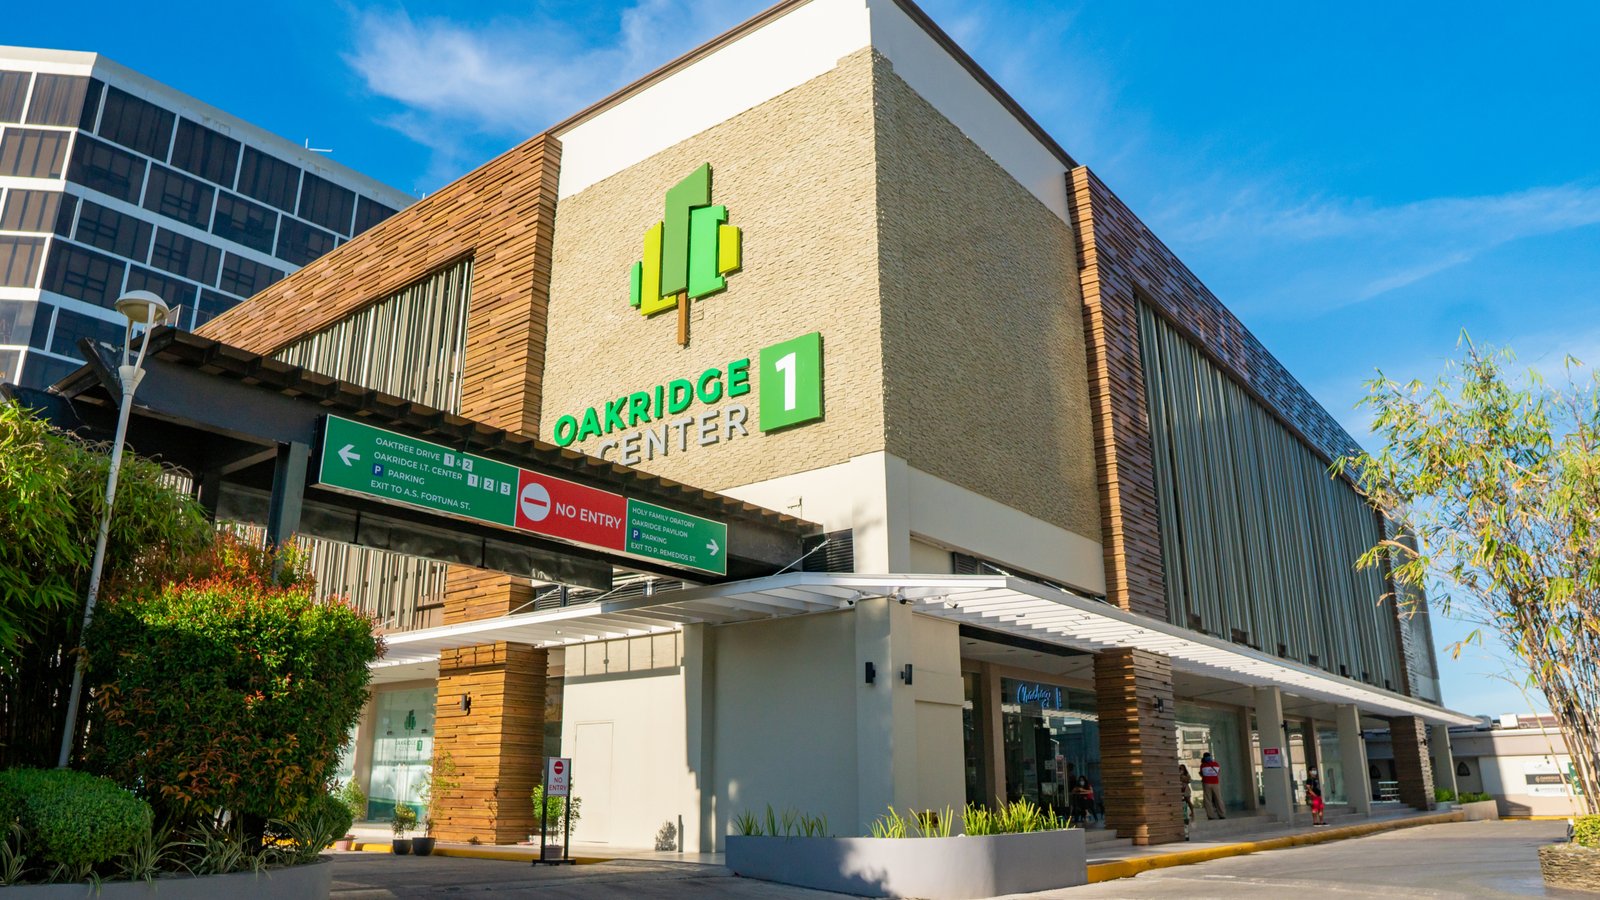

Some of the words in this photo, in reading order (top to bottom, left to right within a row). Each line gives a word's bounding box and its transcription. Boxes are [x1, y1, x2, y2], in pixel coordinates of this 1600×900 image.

[774, 351, 797, 412] 1
[553, 357, 751, 447] OAKRIDGE
[596, 403, 749, 467] CENTER
[374, 451, 418, 469] OAKRIDGE
[419, 463, 430, 473] I.T.
[431, 466, 463, 480] CENTER
[375, 437, 415, 454] OAKTREE
[416, 448, 441, 461] DRIVE
[456, 458, 462, 467] &
[388, 470, 425, 485] PARKING
[370, 479, 389, 491] EXIT
[391, 484, 403, 494] TO
[404, 488, 419, 498] A.S.
[421, 492, 459, 507] FORTUNA
[460, 501, 471, 511] ST.
[555, 502, 576, 519] NO
[580, 510, 622, 529] ENTRY
[631, 518, 662, 532] OAKRIDGE
[662, 526, 688, 538] PAVILION
[632, 507, 648, 516] HOLY
[648, 511, 669, 522] FAMILY
[669, 516, 696, 528] ORATORY
[630, 542, 644, 551] EXIT
[644, 545, 653, 553] TO
[659, 548, 689, 561] REMEDIOS
[641, 532, 667, 544] PARKING
[553, 776, 563, 784] NO
